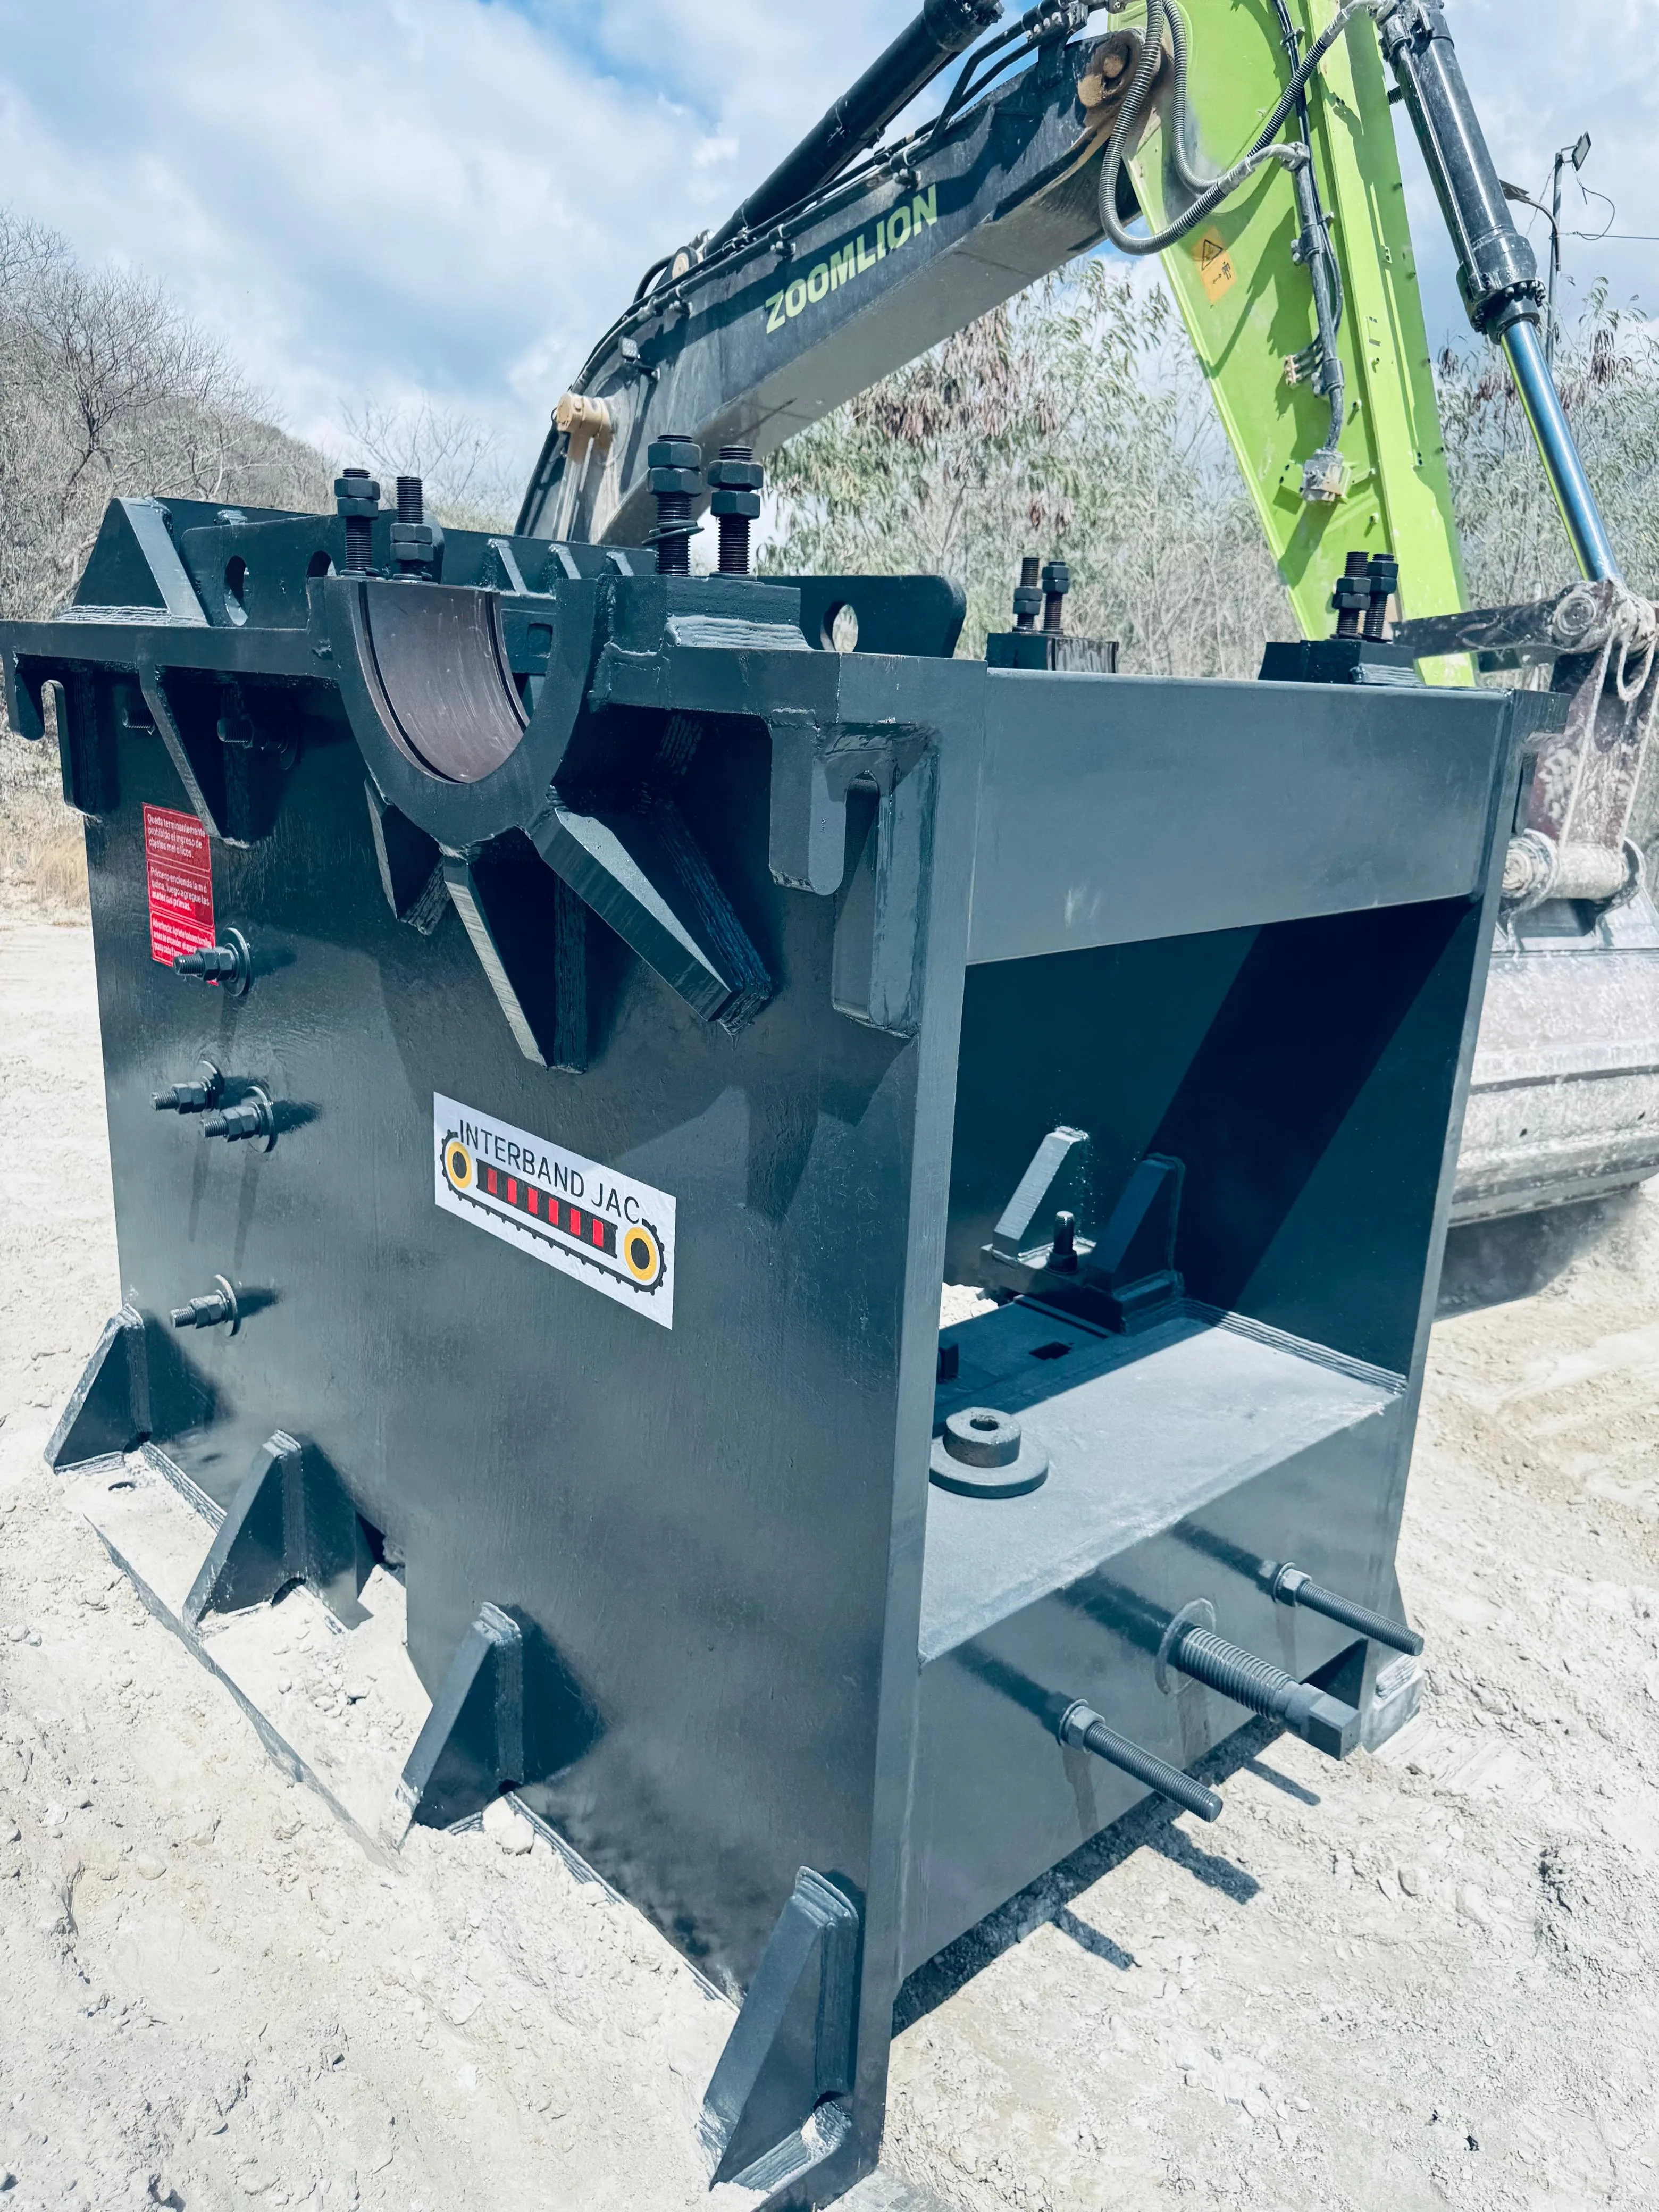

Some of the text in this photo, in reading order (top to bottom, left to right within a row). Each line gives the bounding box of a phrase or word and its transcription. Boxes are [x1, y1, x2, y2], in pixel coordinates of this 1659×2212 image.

[765, 183, 938, 334] ZOOMLION
[147, 814, 205, 838] Queda terminantemente
[148, 827, 202, 849] prohibido el ingreso de
[149, 838, 166, 850] objetos
[150, 866, 170, 881] Primero
[170, 875, 192, 889] encienda
[193, 881, 198, 890] la
[152, 891, 192, 911] materias primas.
[166, 883, 180, 896] luego
[180, 890, 201, 903] agregue
[458, 1119, 640, 1224] INTERBAND JAC
